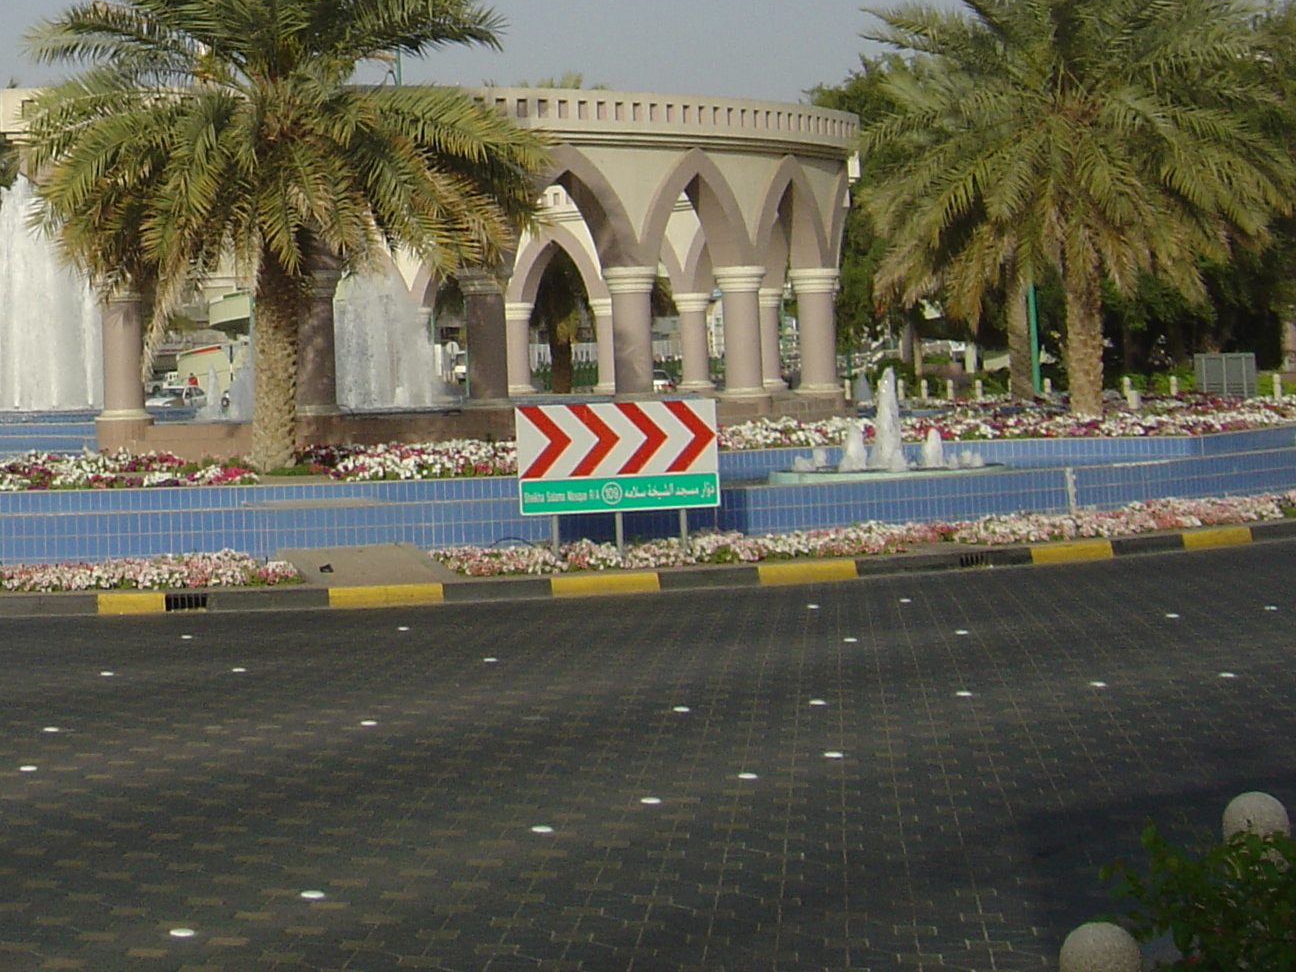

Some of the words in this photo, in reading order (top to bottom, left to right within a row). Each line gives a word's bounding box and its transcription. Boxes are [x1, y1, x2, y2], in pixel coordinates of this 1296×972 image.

[567, 490, 588, 503] Mosque
[605, 487, 619, 499] 109
[675, 487, 699, 498] مسجد
